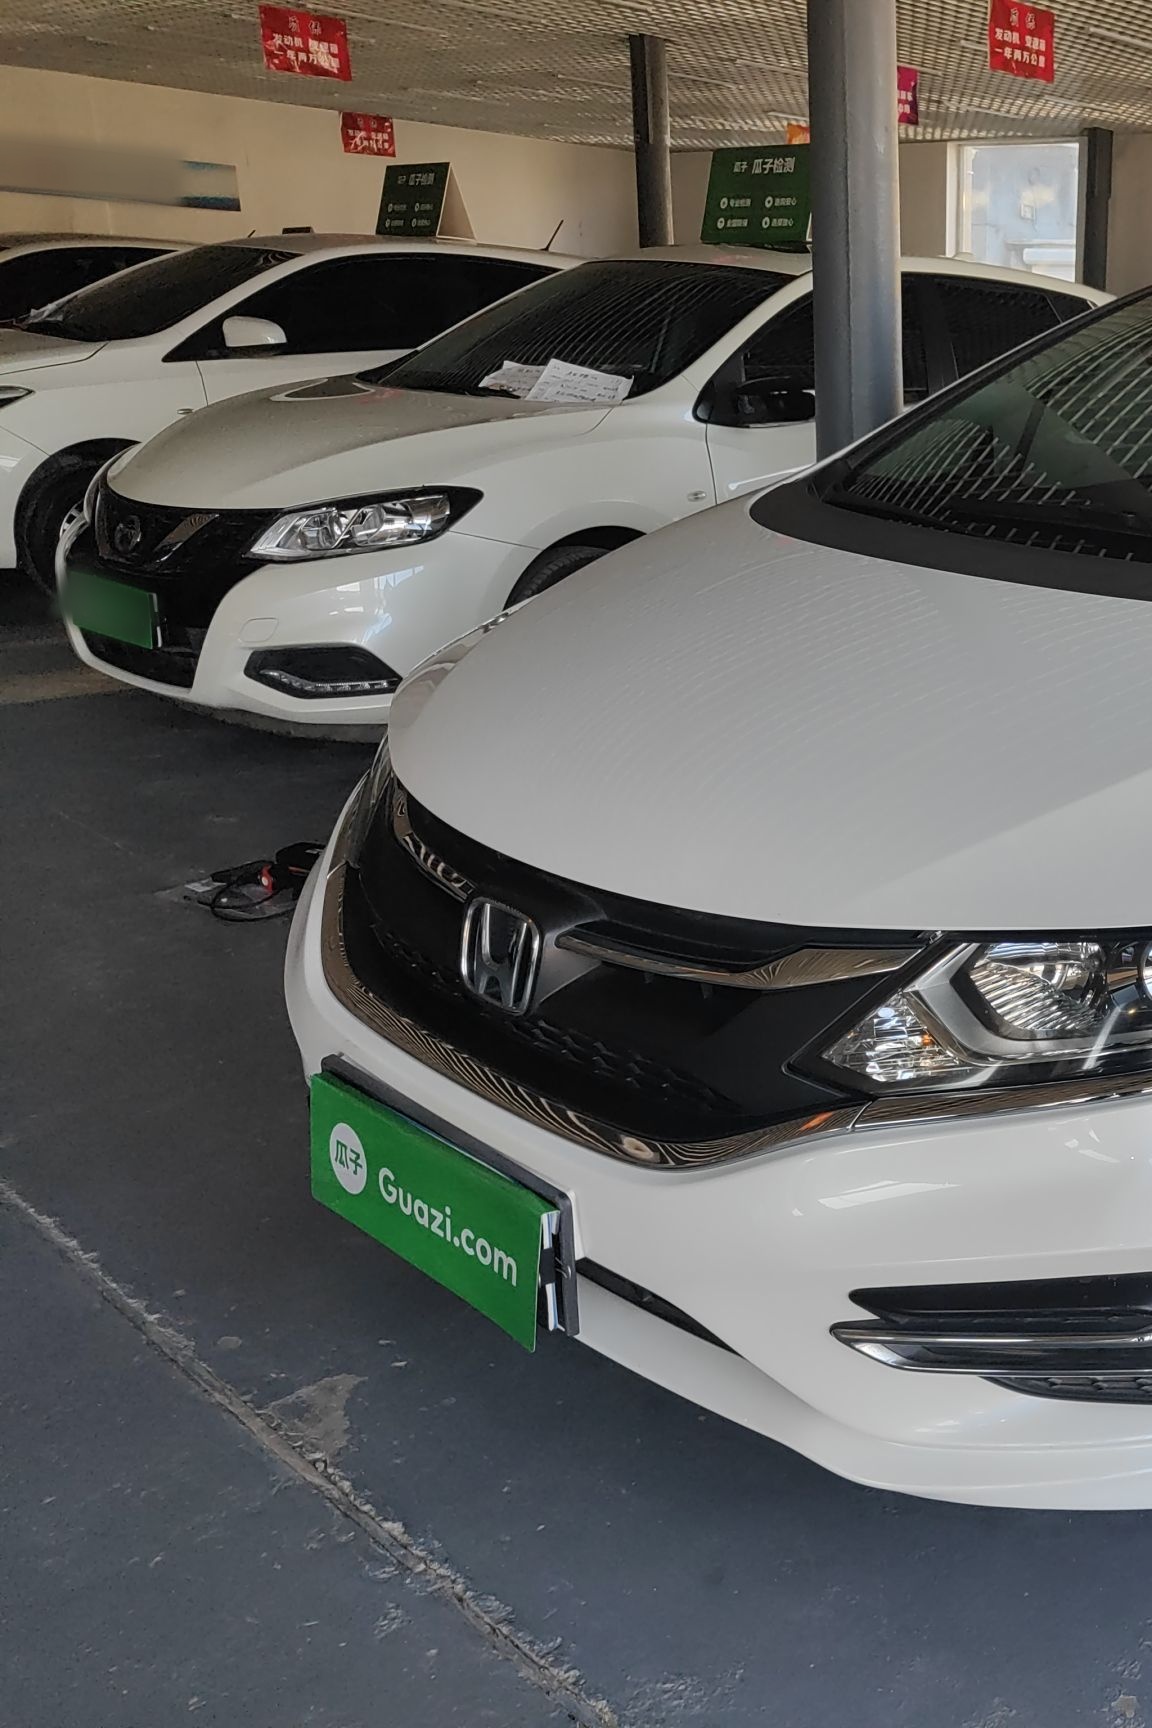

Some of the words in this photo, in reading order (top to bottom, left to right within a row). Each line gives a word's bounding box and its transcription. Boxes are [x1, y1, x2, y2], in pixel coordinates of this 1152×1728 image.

[272, 33, 304, 49] 发动机
[751, 157, 796, 174] 瓜子检测
[334, 1139, 363, 1176] 瓜子
[378, 1167, 518, 1287] Guazi.com
